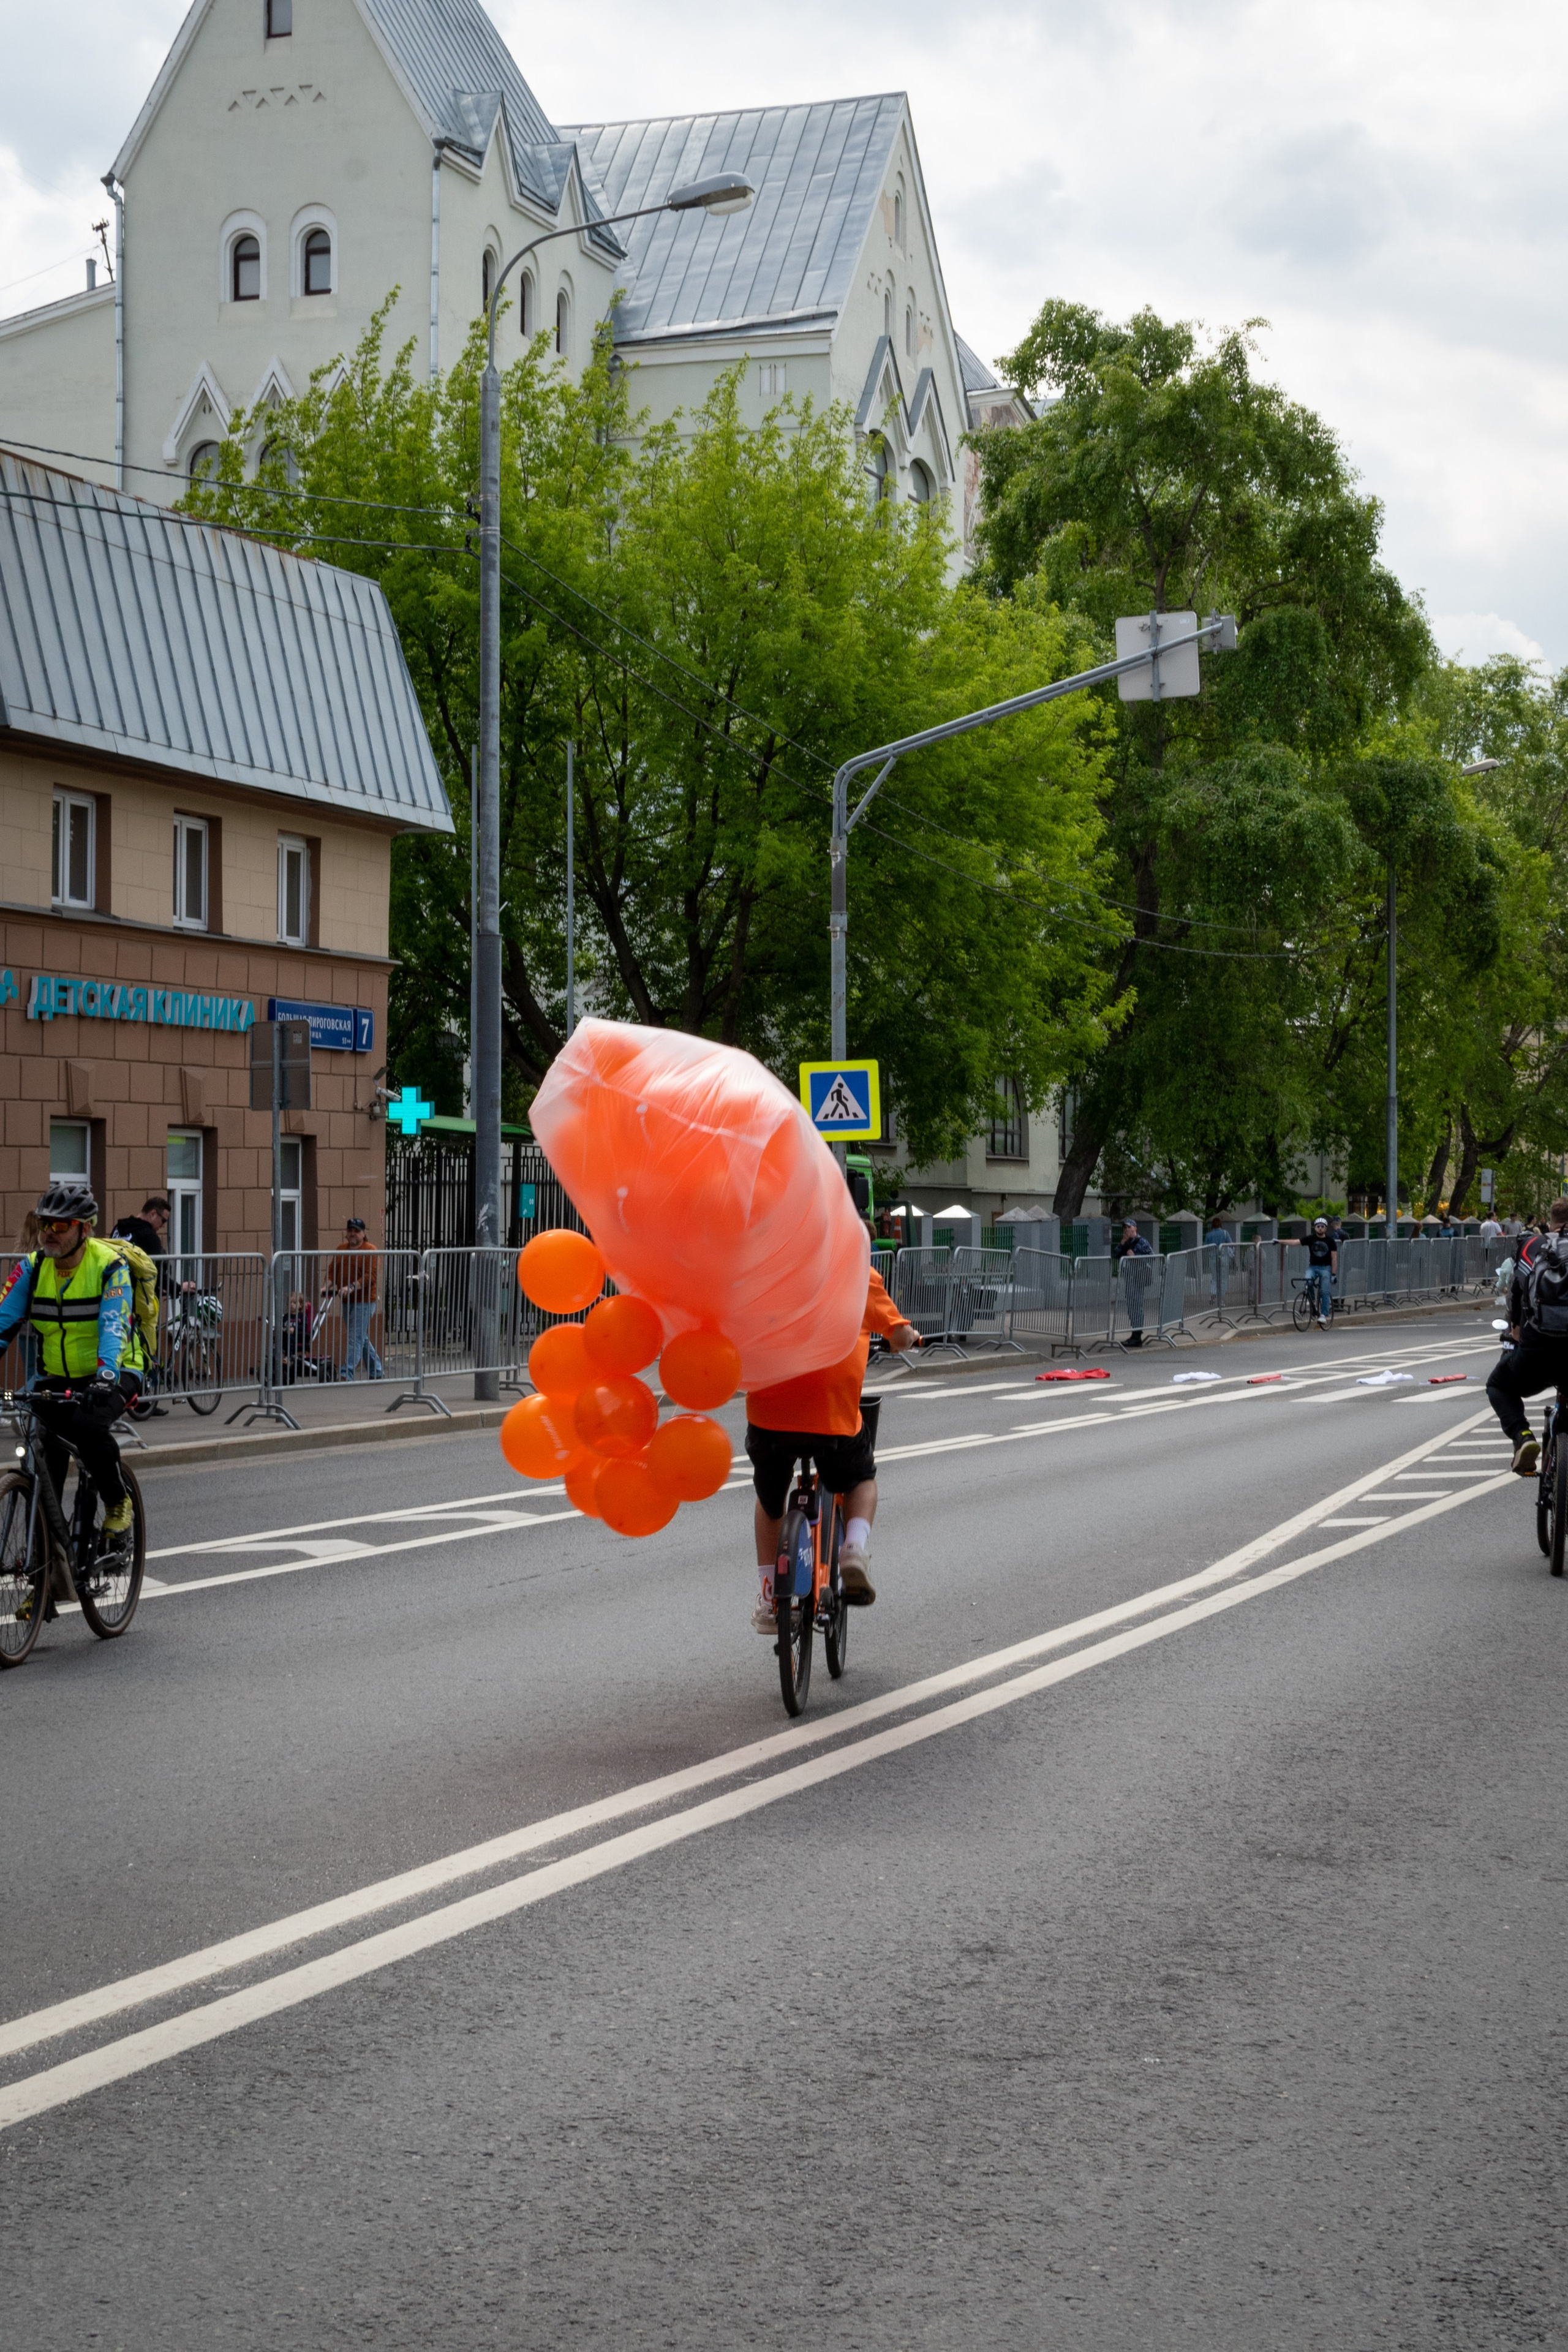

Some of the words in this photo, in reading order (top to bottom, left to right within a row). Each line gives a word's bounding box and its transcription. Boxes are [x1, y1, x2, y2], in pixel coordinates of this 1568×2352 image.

[29, 976, 147, 1022] ДЕТСКАЯ
[149, 989, 255, 1032] КЛИНИКА
[308, 1016, 351, 1031] ПИРОГОВСКАЯ
[361, 1018, 369, 1045] 7
